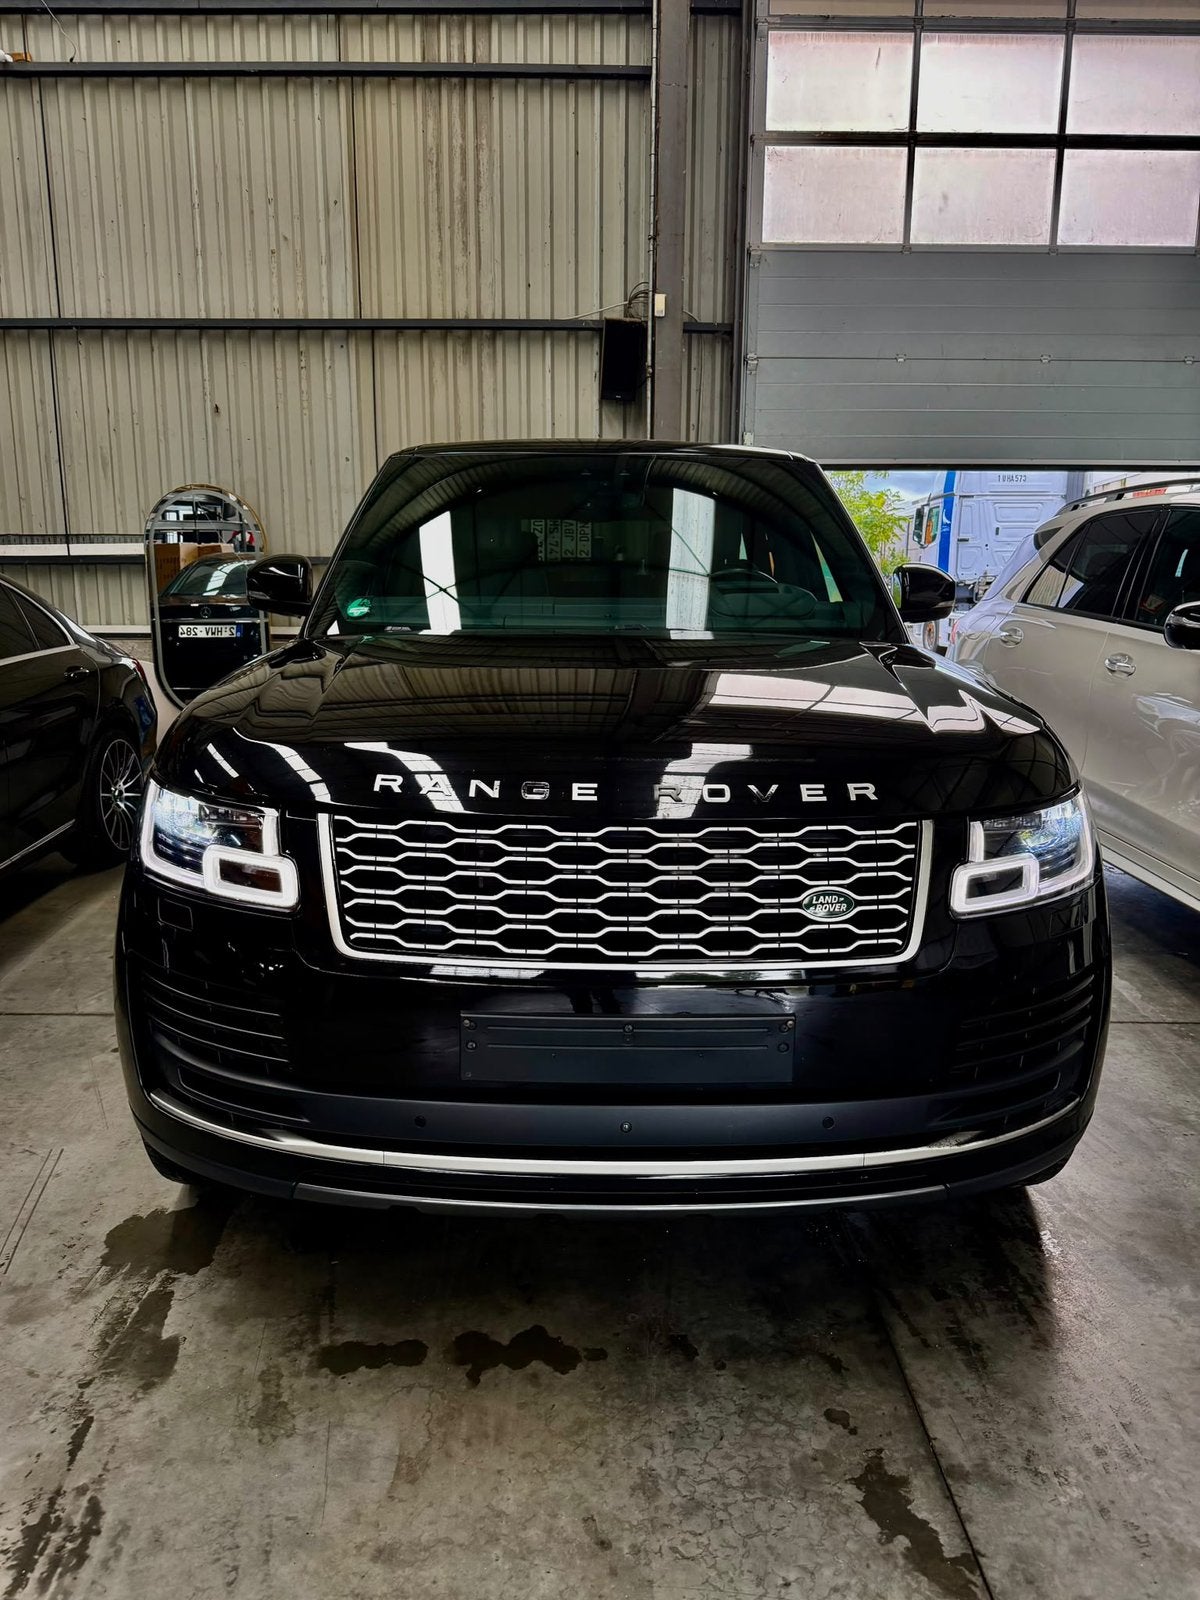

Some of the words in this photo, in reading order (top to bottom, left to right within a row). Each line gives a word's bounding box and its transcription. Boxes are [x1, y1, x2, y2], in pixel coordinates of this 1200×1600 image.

[373, 773, 599, 801] RANGE
[654, 782, 879, 803] ROVER
[812, 895, 838, 904] LAND
[815, 903, 847, 912] ROVER
